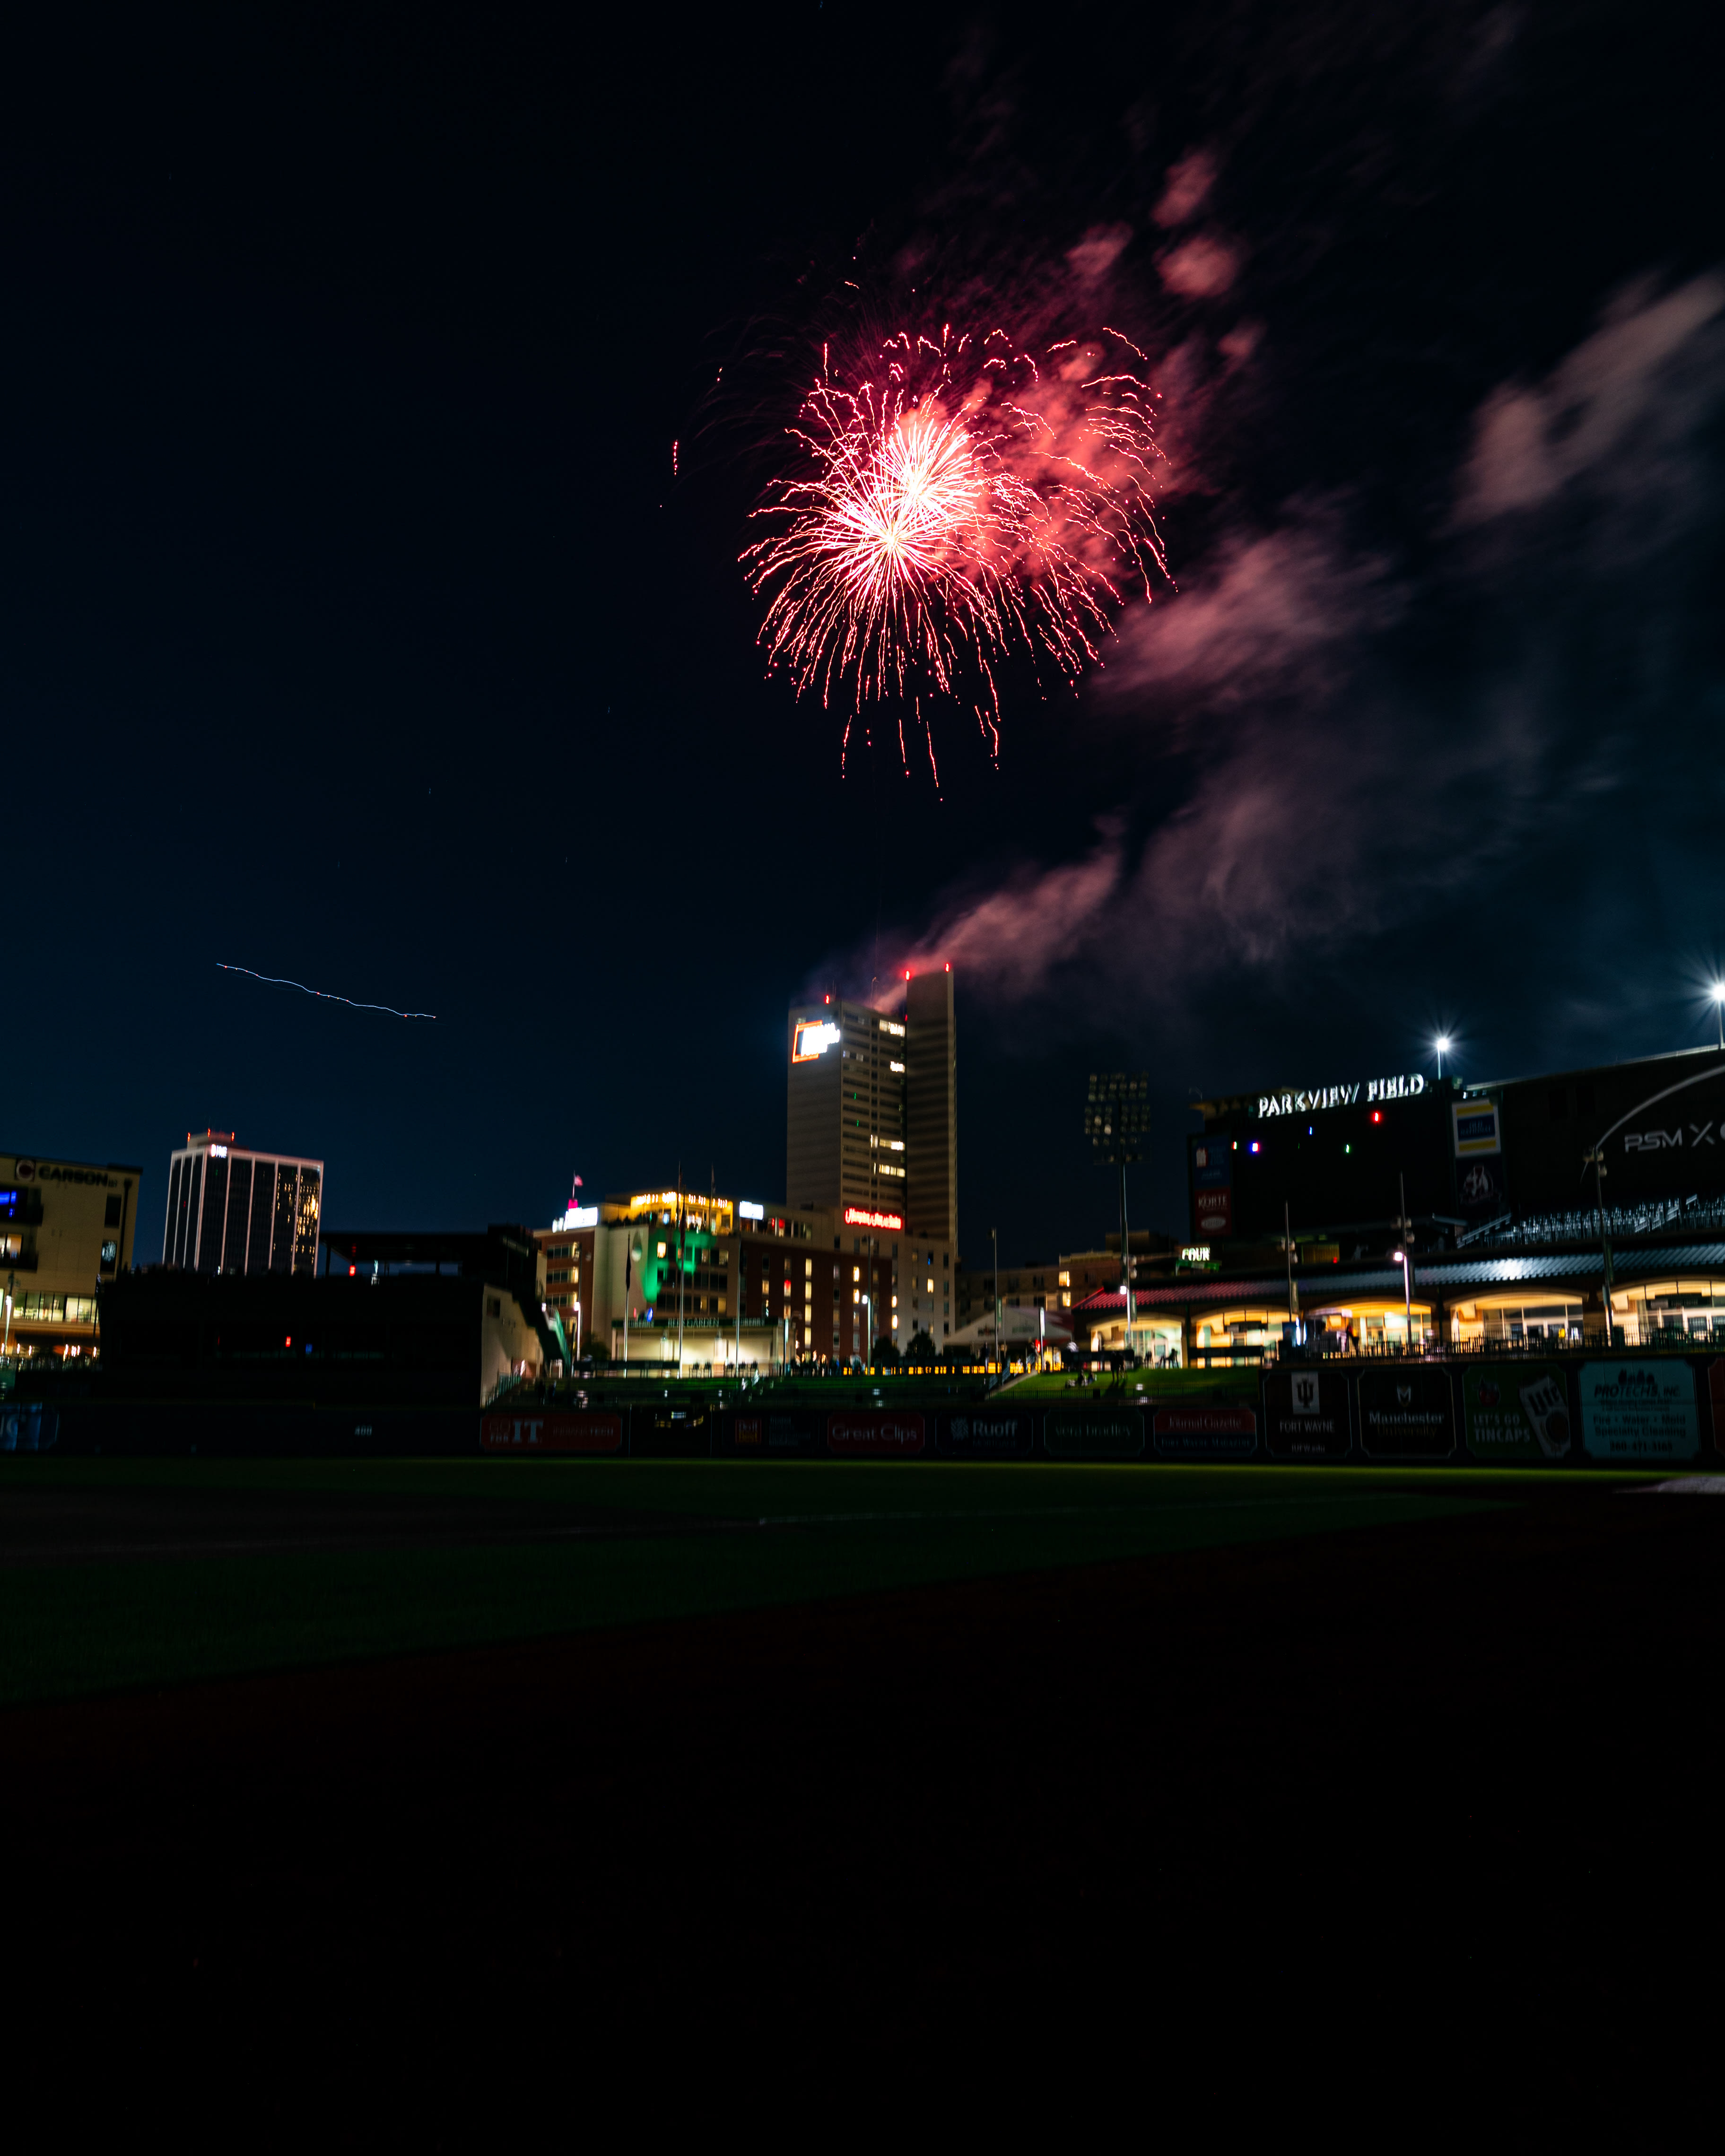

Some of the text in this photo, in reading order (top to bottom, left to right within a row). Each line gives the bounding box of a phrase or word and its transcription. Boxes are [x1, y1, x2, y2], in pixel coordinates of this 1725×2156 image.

[1257, 1073, 1424, 1119] PARKVIEW FIELD
[39, 1165, 108, 1187] CARSON
[1279, 1417, 1336, 1434] FORT WAYNE
[1368, 1409, 1445, 1426] Manchester
[1503, 1411, 1521, 1427] GO
[832, 1423, 878, 1442] Great
[880, 1423, 917, 1445] Clips
[972, 1418, 1018, 1438] Ruoff
[1377, 1423, 1438, 1441] University
[1473, 1426, 1531, 1443] TINCAPS
